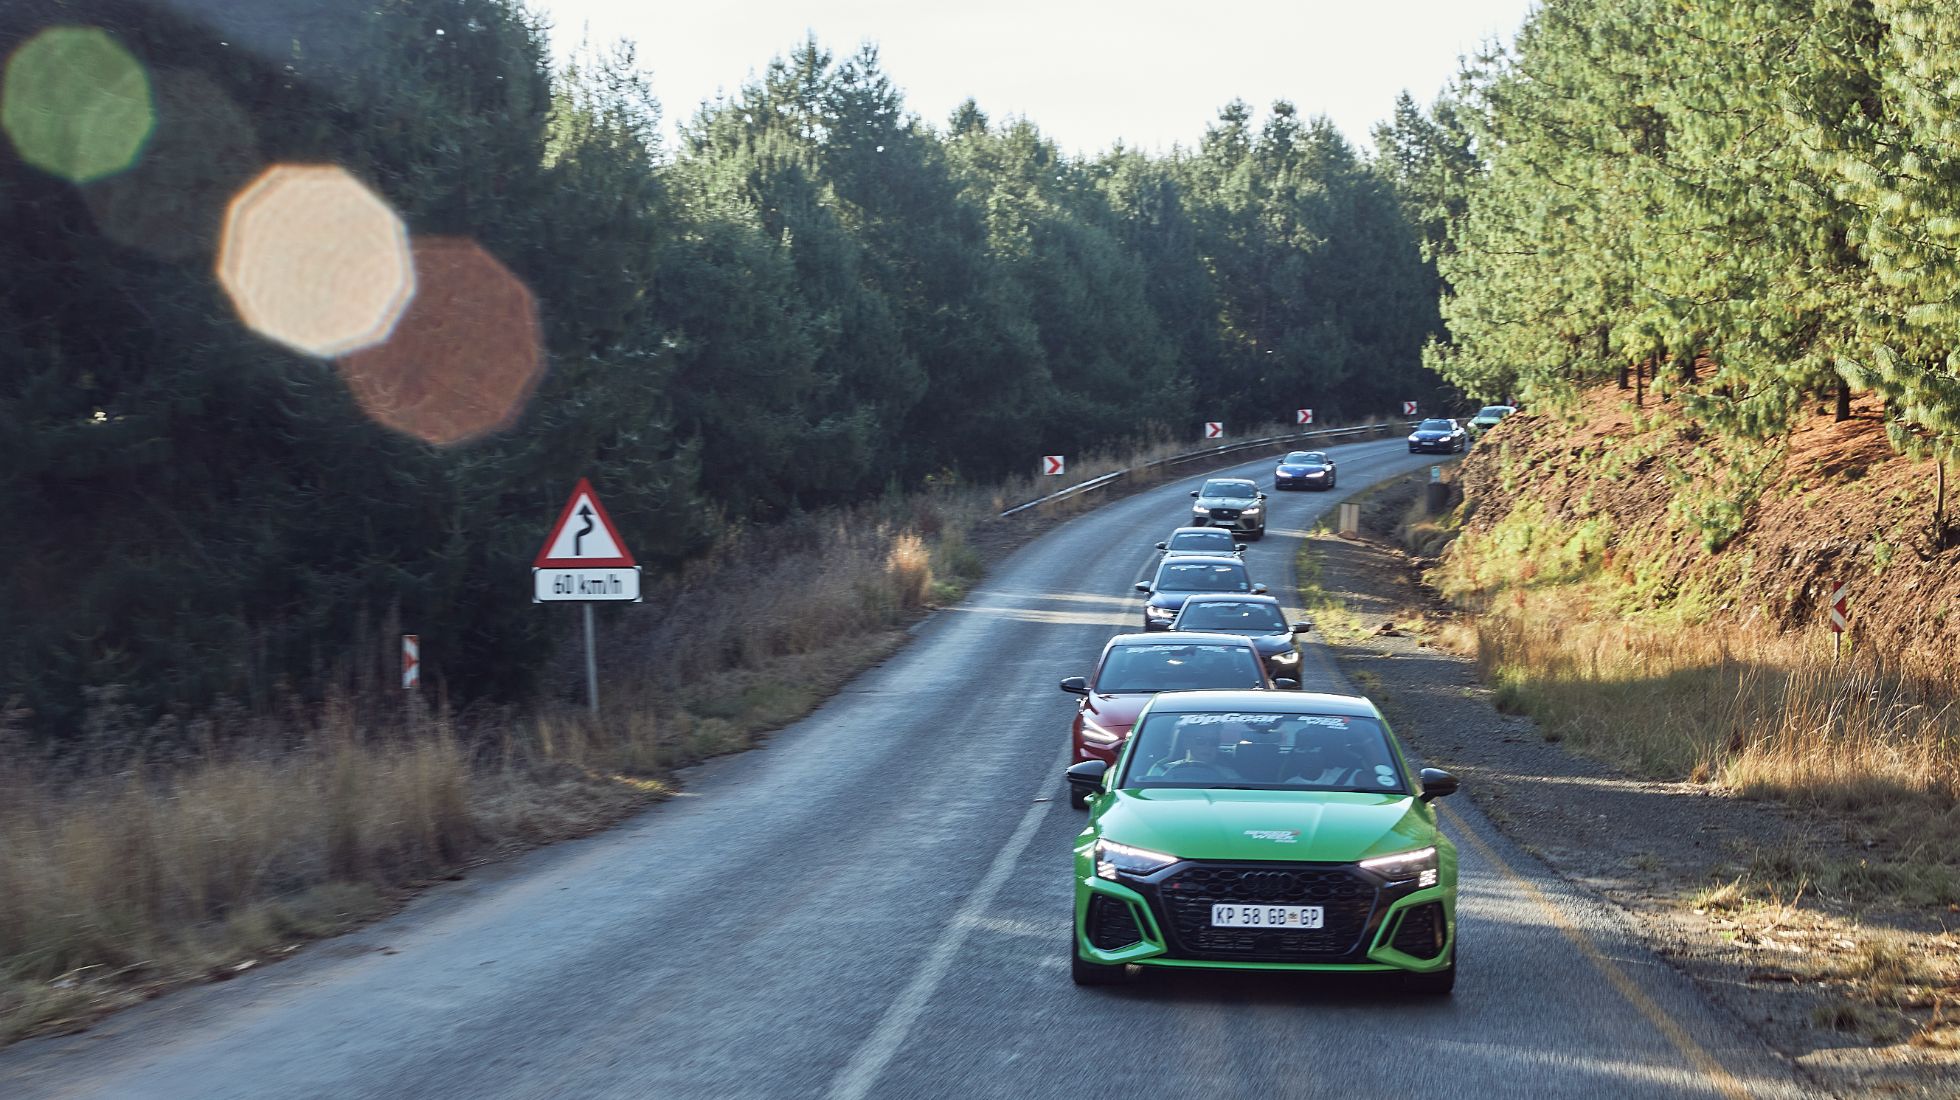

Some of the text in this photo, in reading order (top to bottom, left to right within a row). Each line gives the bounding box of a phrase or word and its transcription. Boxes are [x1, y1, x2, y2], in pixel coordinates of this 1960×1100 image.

[553, 574, 622, 594] 60 km/h
[1178, 713, 1283, 725] TopGear
[1216, 907, 1319, 925] KP 58 GB GP
